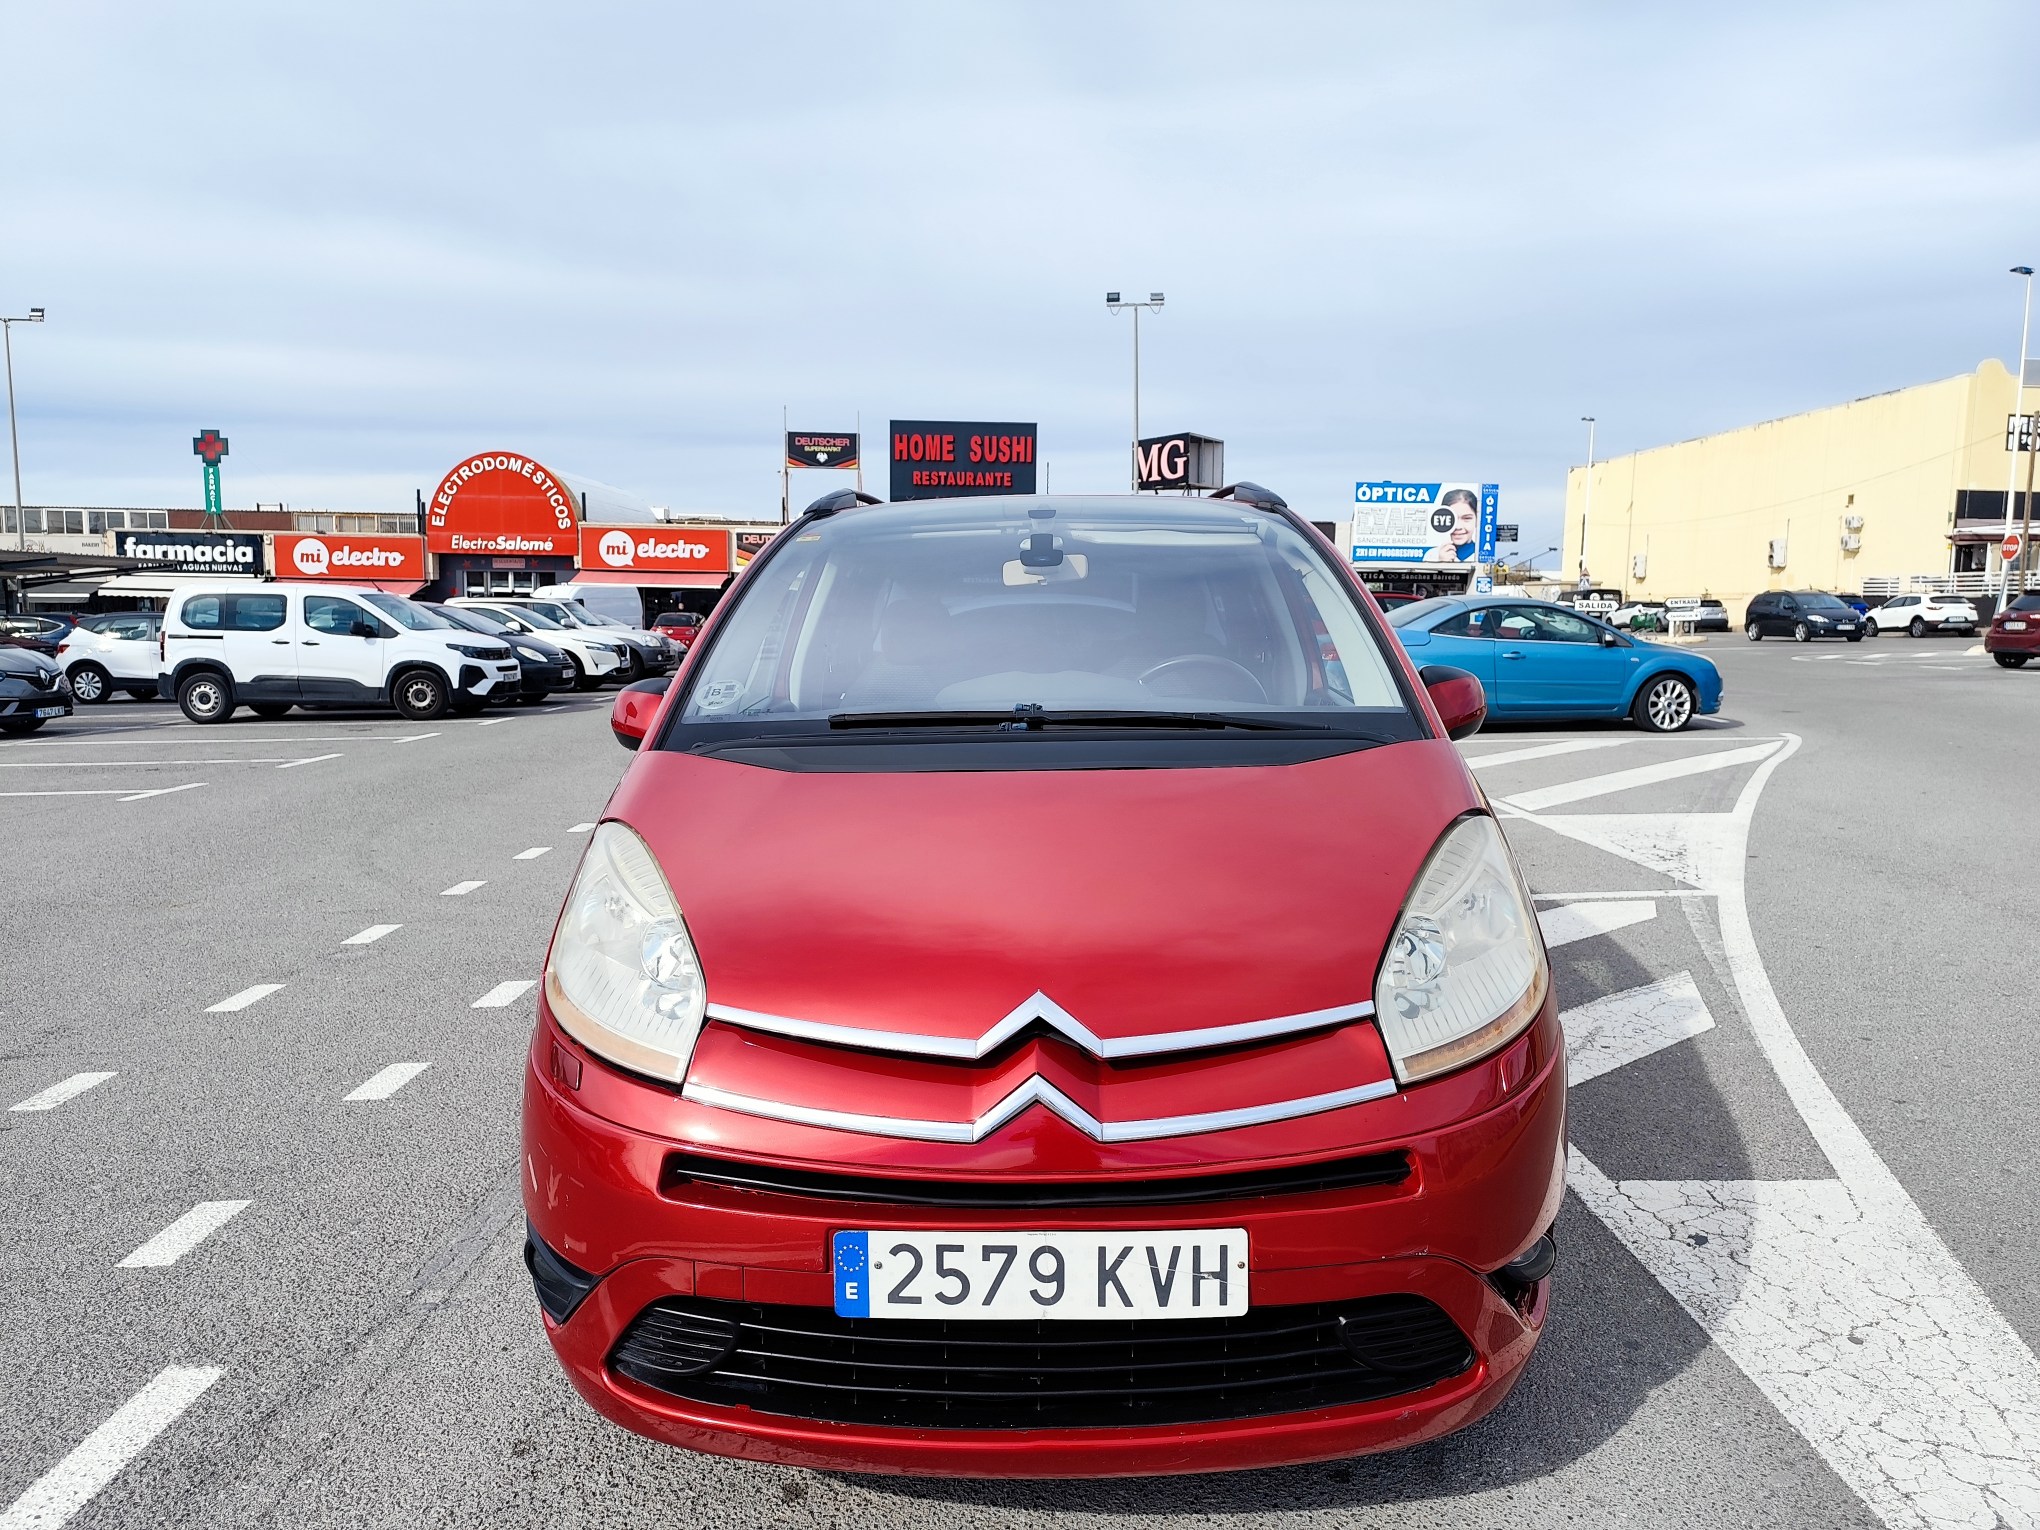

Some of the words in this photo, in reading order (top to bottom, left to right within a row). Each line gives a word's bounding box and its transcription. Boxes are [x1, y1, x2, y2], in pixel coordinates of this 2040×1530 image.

[795, 437, 850, 446] DEUTSCHER
[894, 434, 954, 461] HOME
[969, 435, 1033, 463] SUSHI
[1138, 439, 1187, 482] MG
[912, 471, 1012, 487] RESTAURANTE
[208, 467, 217, 512] FARMACIA
[431, 456, 571, 530] ELECTRODOMÉSTICOS
[1357, 484, 1431, 502] ÓPTICA
[1433, 515, 1452, 526] EYE
[451, 535, 554, 551] ElectroSalomé
[742, 534, 773, 544] DEUT
[1391, 537, 1428, 545] BARREDO
[123, 536, 253, 563] farmacia
[300, 549, 322, 563] mi
[331, 545, 405, 567] electro
[606, 541, 629, 555] mi
[637, 537, 709, 559] electro
[1377, 549, 1424, 558] PROGRESIVOS
[2002, 544, 2018, 552] STOP
[182, 563, 209, 571] AGUAS
[211, 564, 243, 572] NUEVAS
[888, 1243, 1065, 1307] 2579
[1098, 1244, 1228, 1308] KVH
[846, 1282, 858, 1299] E
